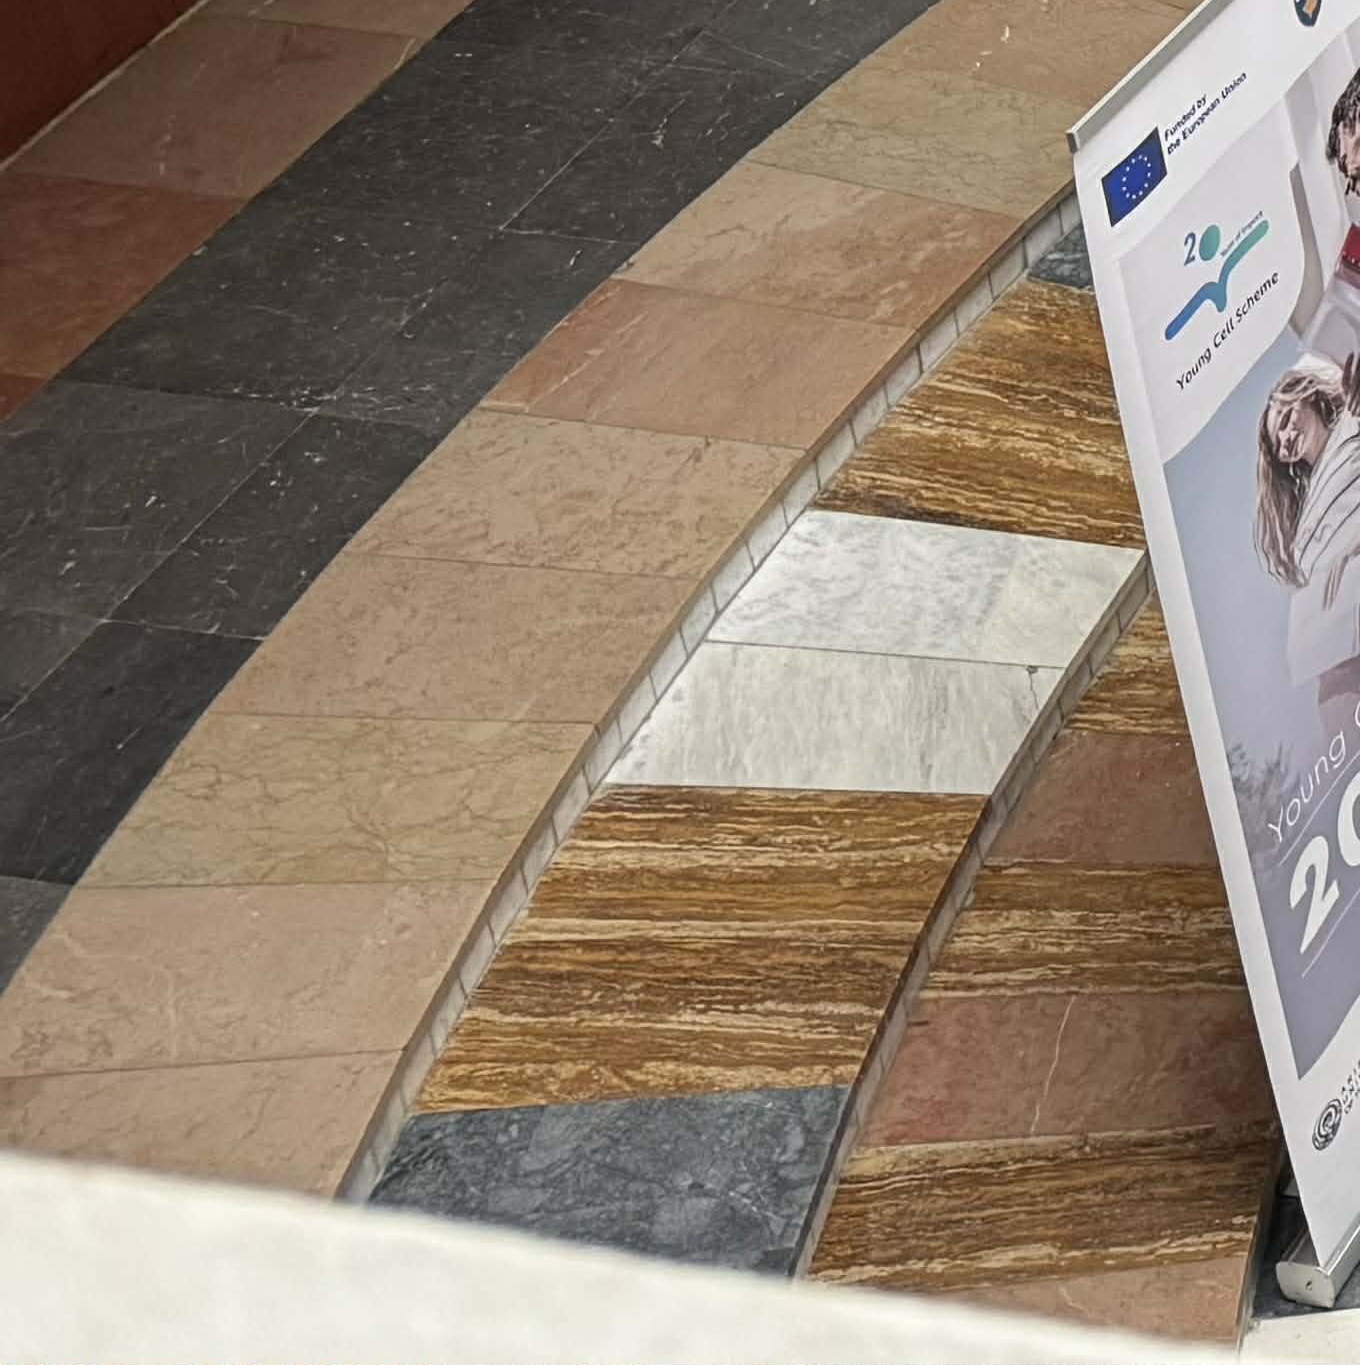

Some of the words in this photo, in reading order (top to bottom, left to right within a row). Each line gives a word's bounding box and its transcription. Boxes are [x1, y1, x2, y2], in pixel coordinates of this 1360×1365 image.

[1164, 104, 1196, 142] Funded
[1196, 94, 1207, 109] by
[1167, 138, 1181, 155] the
[1181, 98, 1220, 140] European
[1221, 72, 1247, 99] Union
[1176, 347, 1212, 391] Young
[1213, 317, 1235, 348] Cell
[1236, 271, 1279, 323] Scheme
[1268, 729, 1347, 845] Young
